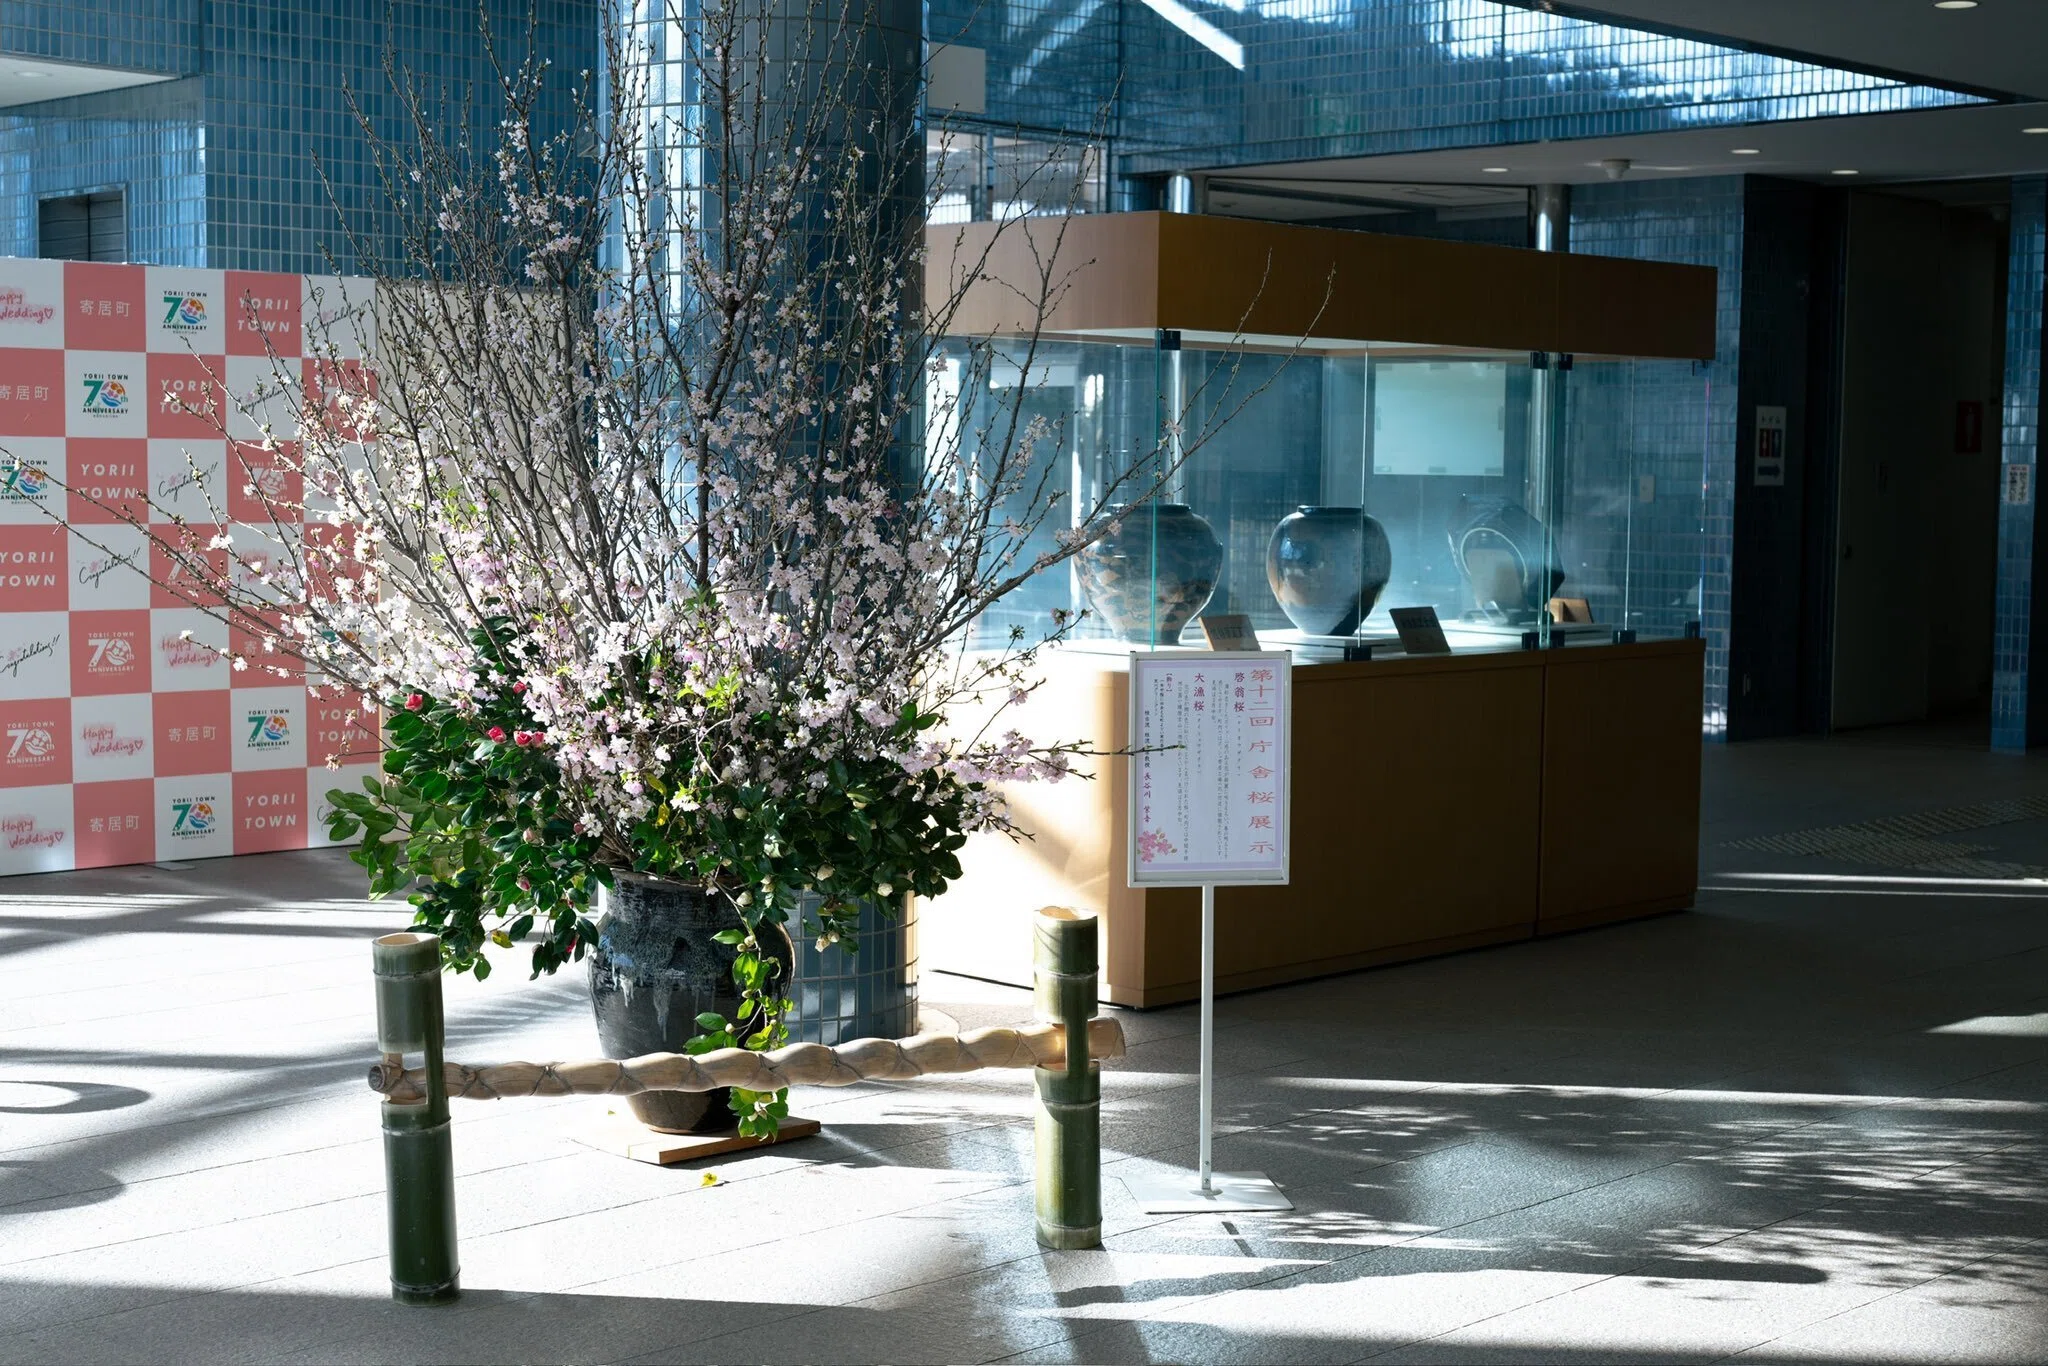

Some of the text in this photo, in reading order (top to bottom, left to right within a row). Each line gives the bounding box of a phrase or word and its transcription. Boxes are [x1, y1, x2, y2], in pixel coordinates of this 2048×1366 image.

[0, 293, 22, 304] appy
[239, 297, 289, 310] YORII
[80, 300, 130, 317] 寄居町
[238, 320, 290, 332] TOWN
[0, 386, 49, 400] 寄居町
[83, 380, 128, 407] 70th
[81, 464, 134, 476] YORII
[80, 487, 135, 499] TOWN
[0, 551, 54, 563] YORII
[0, 575, 55, 587] TOWN
[162, 637, 191, 651] Happy
[168, 654, 212, 667] Wedding
[1193, 672, 1205, 712] 大漁桜
[1234, 672, 1245, 713] 啓翁桜
[83, 728, 114, 740] Happy
[168, 726, 217, 742] 寄居町
[319, 730, 368, 742] TOWN
[91, 740, 134, 756] Wedding
[7, 756, 55, 764] ANNIVERSARY
[1248, 669, 1275, 854] 第十二回庁舎桜展示
[246, 793, 296, 807] YORII
[1, 819, 33, 832] Happy
[90, 815, 139, 832] 寄居町
[245, 815, 297, 829] TOWN
[9, 834, 55, 848] Wedding
